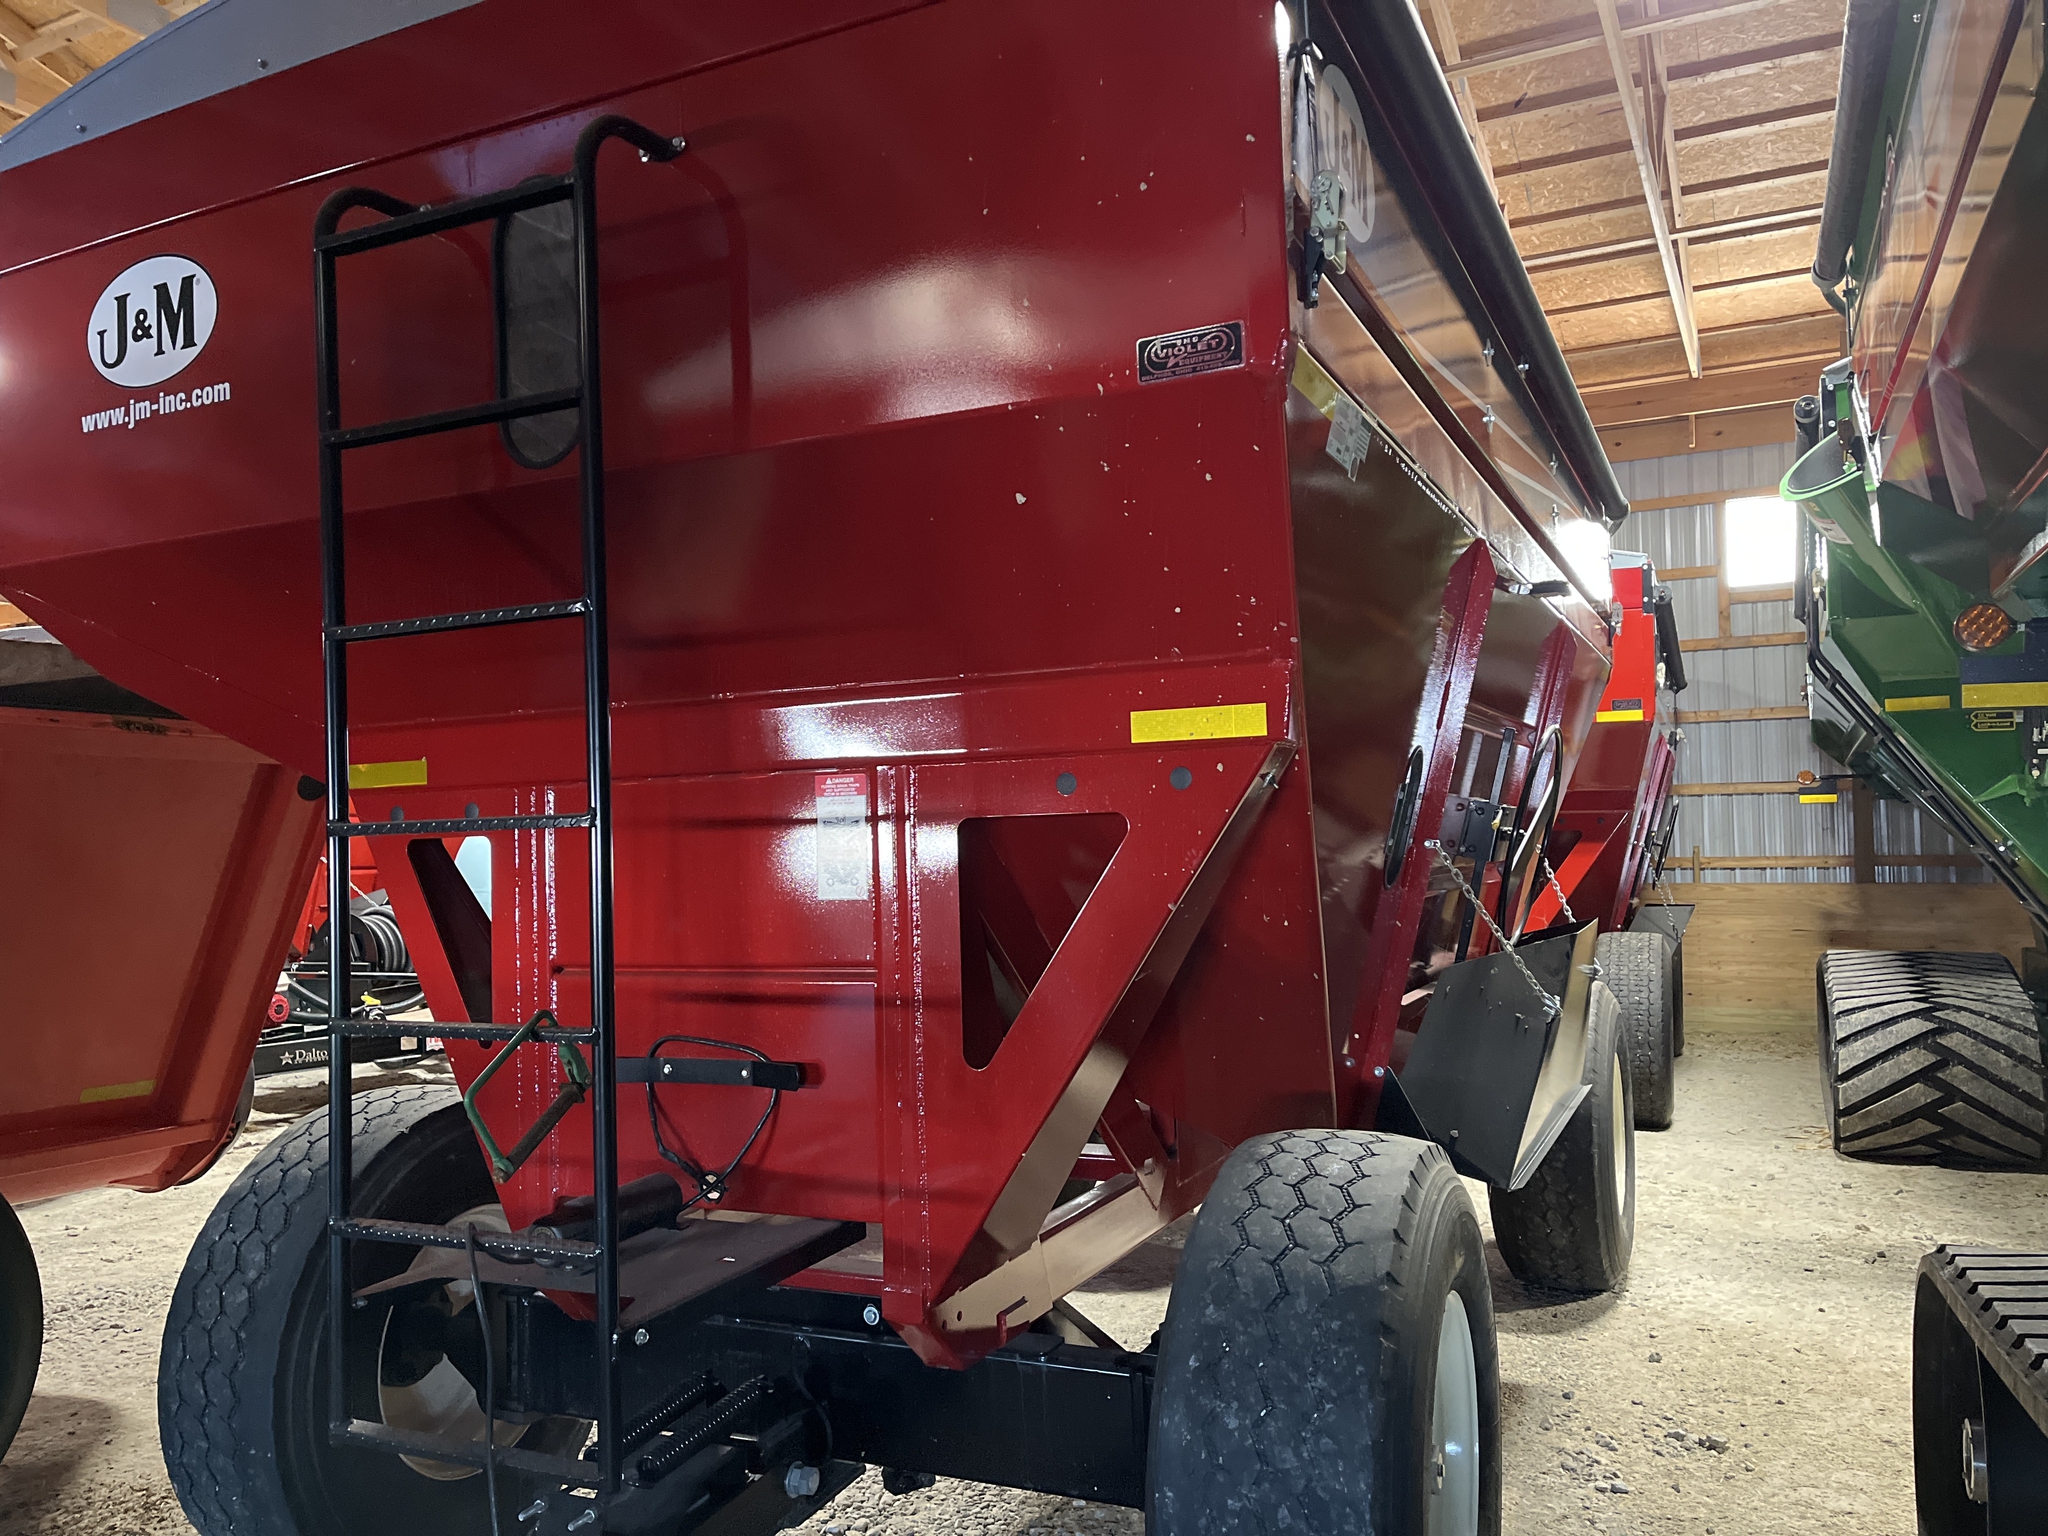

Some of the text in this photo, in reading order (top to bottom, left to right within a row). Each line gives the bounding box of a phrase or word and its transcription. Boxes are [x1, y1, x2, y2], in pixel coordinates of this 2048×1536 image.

[97, 274, 198, 369] J&M
[1158, 338, 1219, 357] VIOLET
[1179, 352, 1228, 366] EQUIPMENT
[82, 381, 231, 433] www.jm-inc.com
[295, 1048, 329, 1060] Dalto
